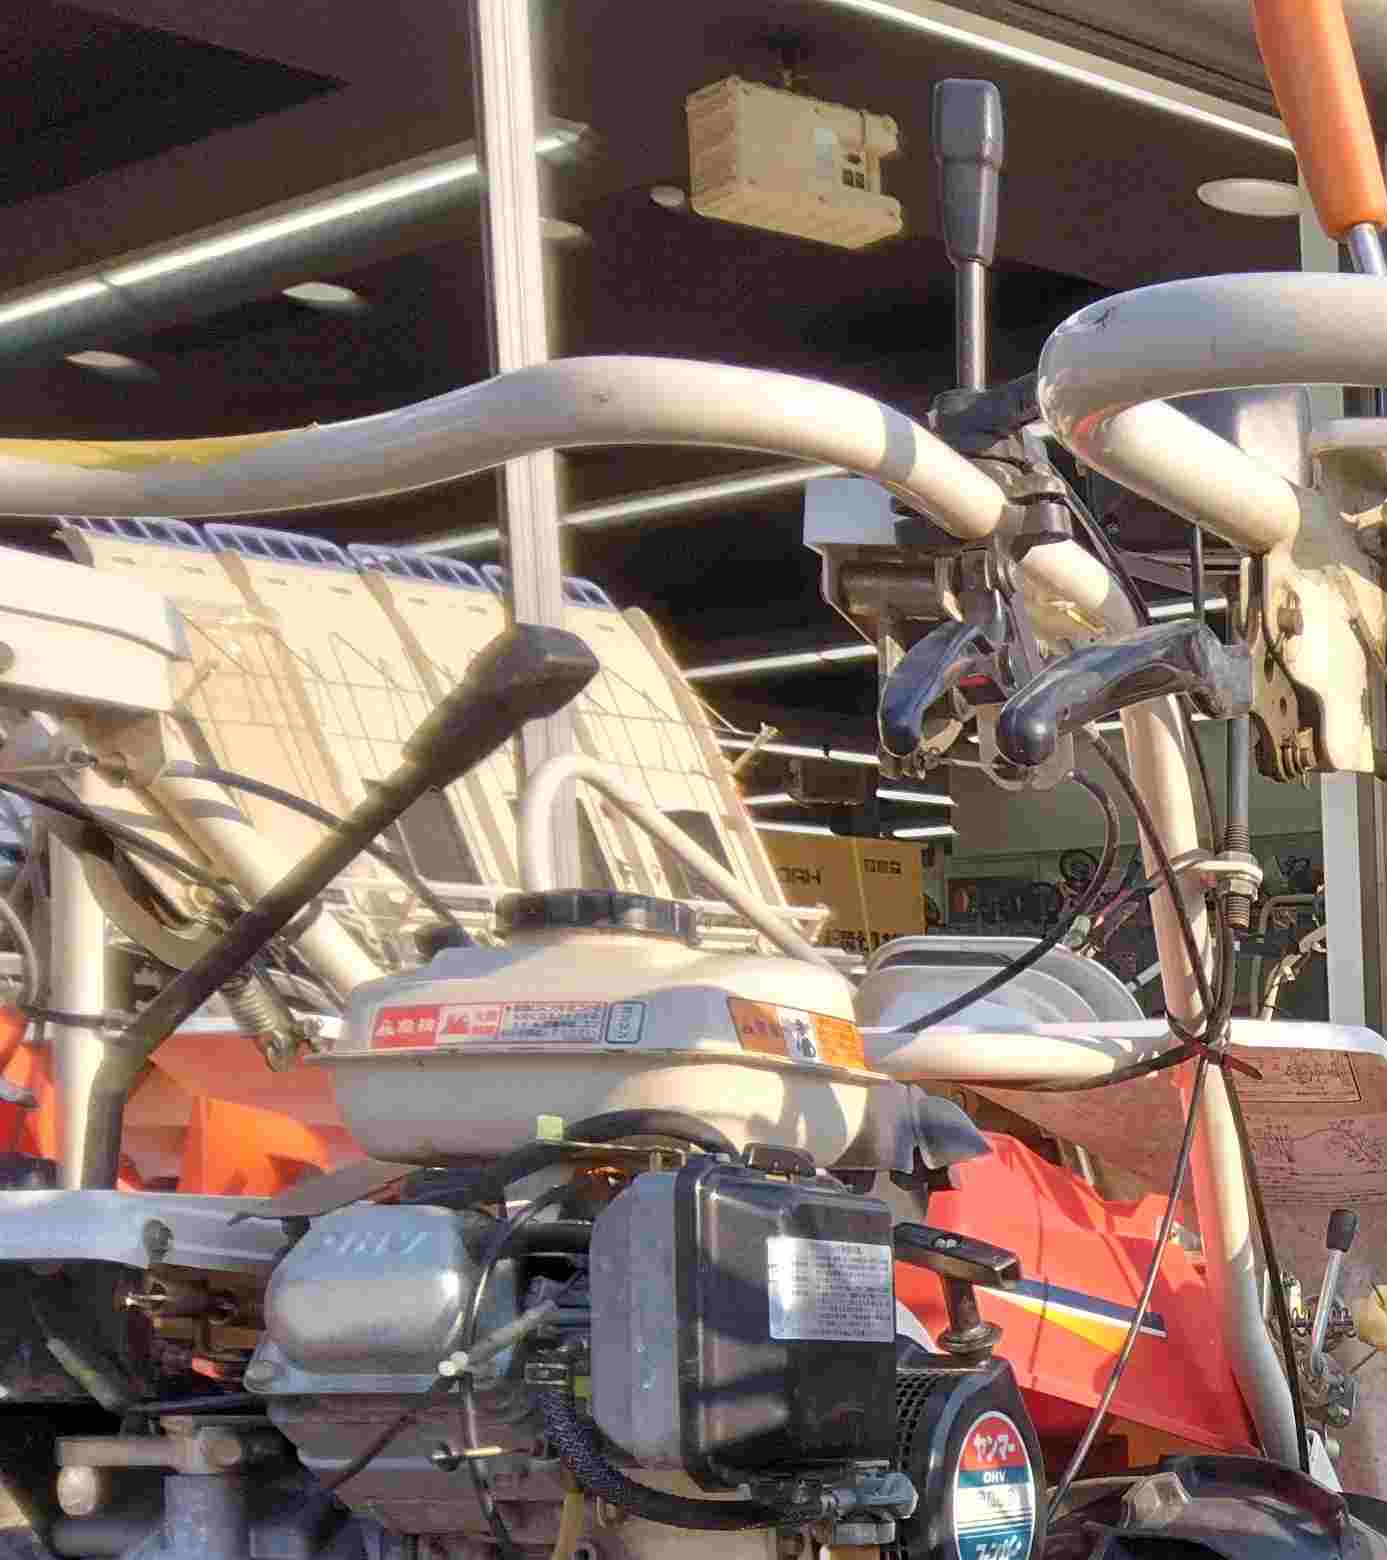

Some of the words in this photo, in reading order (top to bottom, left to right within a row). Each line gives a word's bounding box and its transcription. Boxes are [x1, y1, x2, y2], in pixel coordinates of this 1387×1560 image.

[973, 1433, 1017, 1463] ヤンマー
[983, 1470, 1006, 1484] OHV
